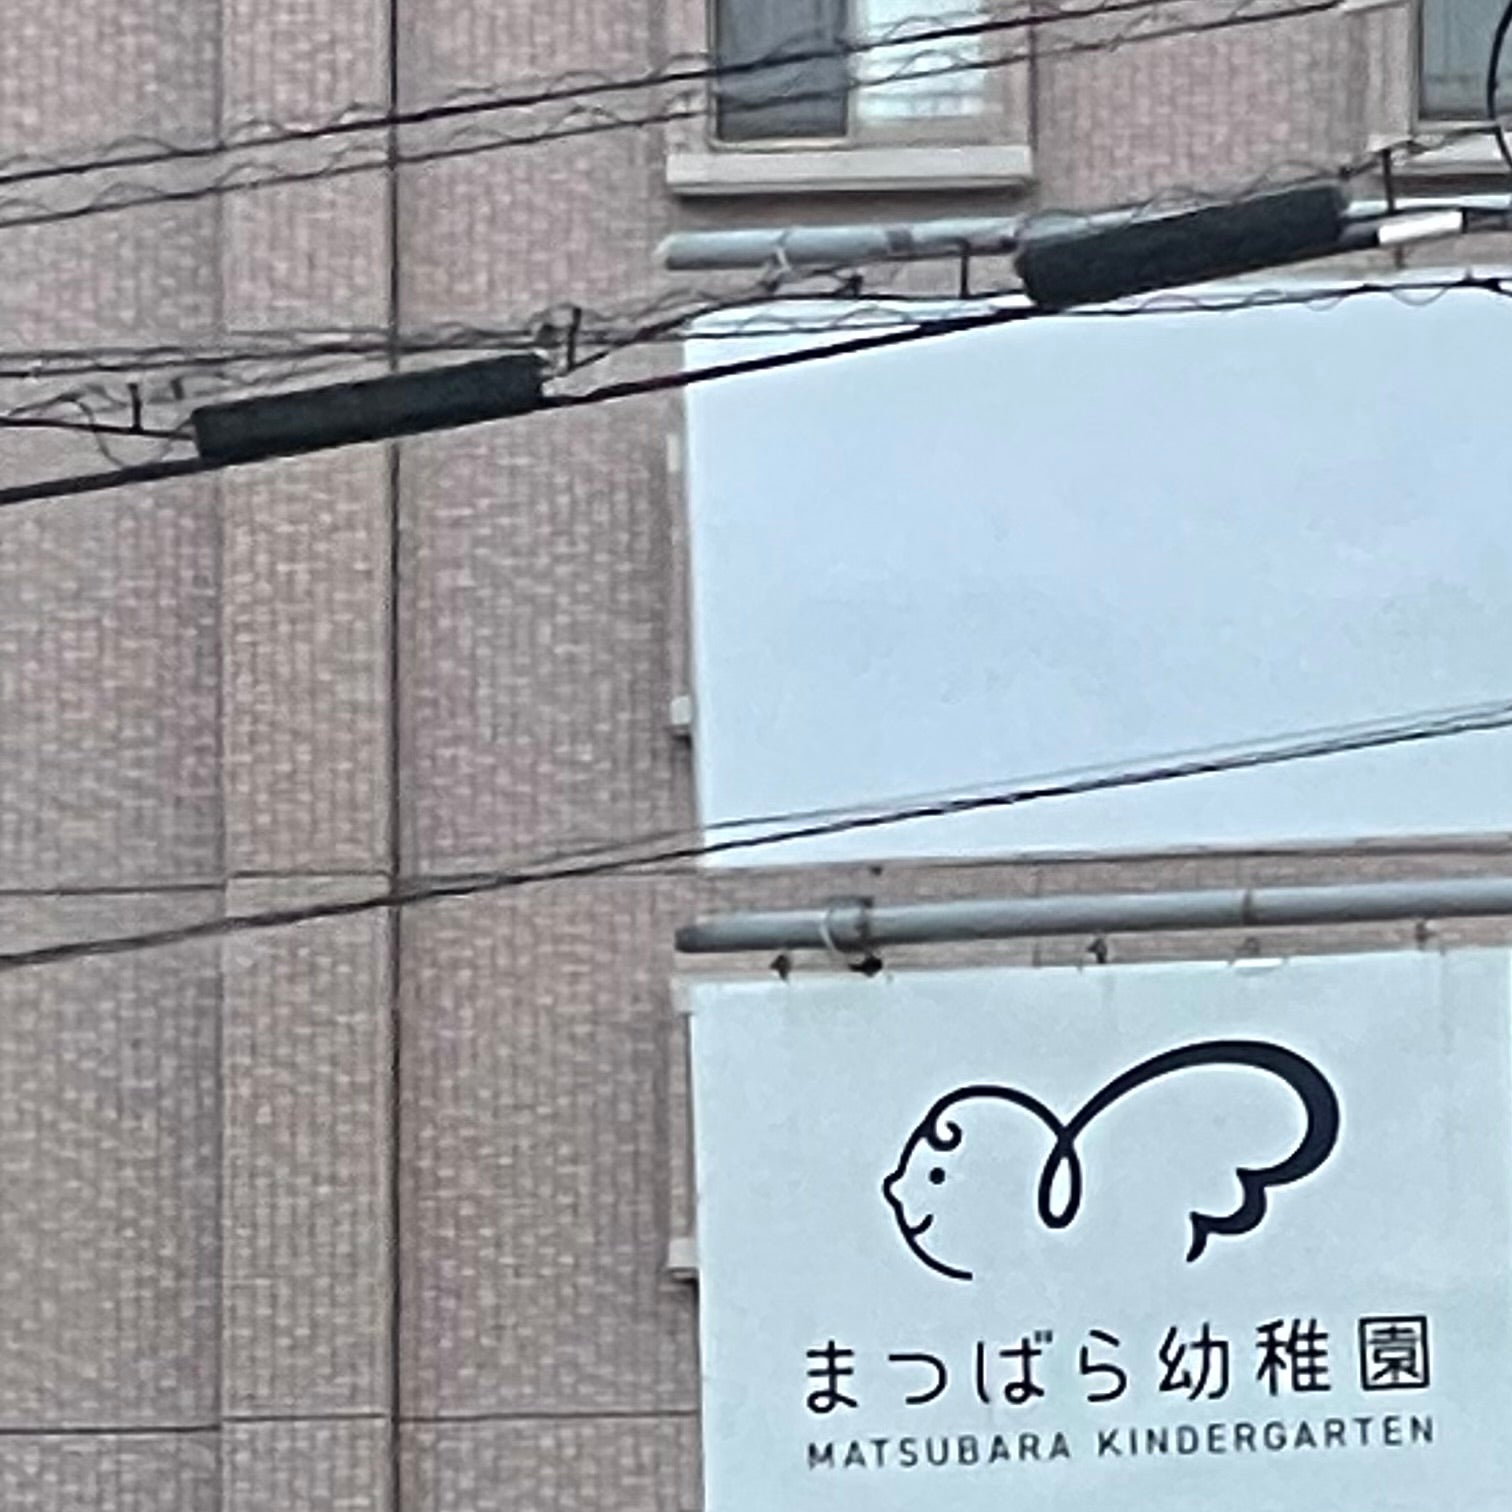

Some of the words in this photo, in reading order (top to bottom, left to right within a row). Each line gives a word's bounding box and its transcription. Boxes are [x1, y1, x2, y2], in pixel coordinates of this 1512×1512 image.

[806, 1315, 1430, 1413] まつばら幼稚園
[808, 1431, 1072, 1469] MATSUBARA
[1098, 1414, 1435, 1458] KINDERGARTEN
